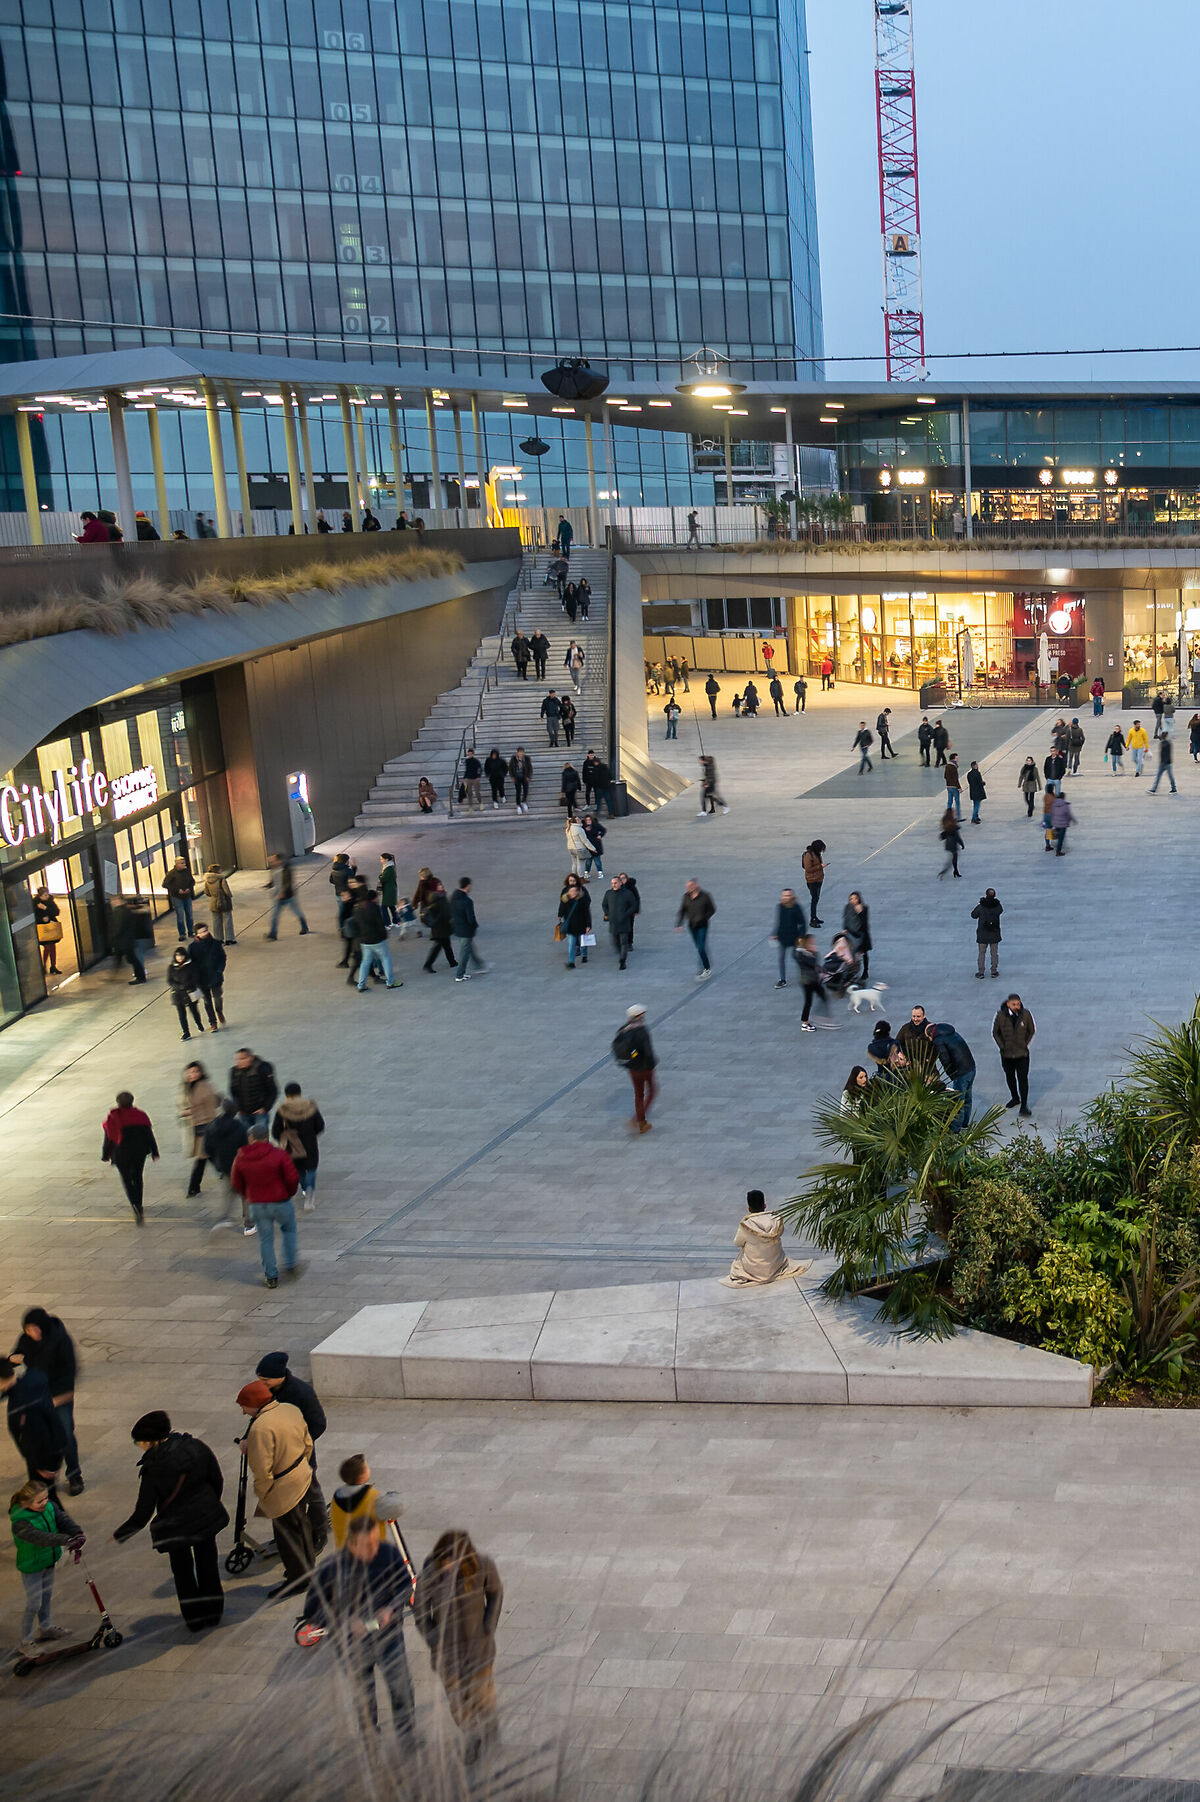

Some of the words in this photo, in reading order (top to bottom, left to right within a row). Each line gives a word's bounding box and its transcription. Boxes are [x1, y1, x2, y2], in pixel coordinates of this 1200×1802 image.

[326, 31, 363, 50] 06
[333, 104, 369, 121] 05
[339, 176, 380, 193] 04
[894, 236, 908, 251] A
[342, 245, 384, 263] 03
[345, 315, 389, 333] 02
[1, 759, 108, 846] CityLife
